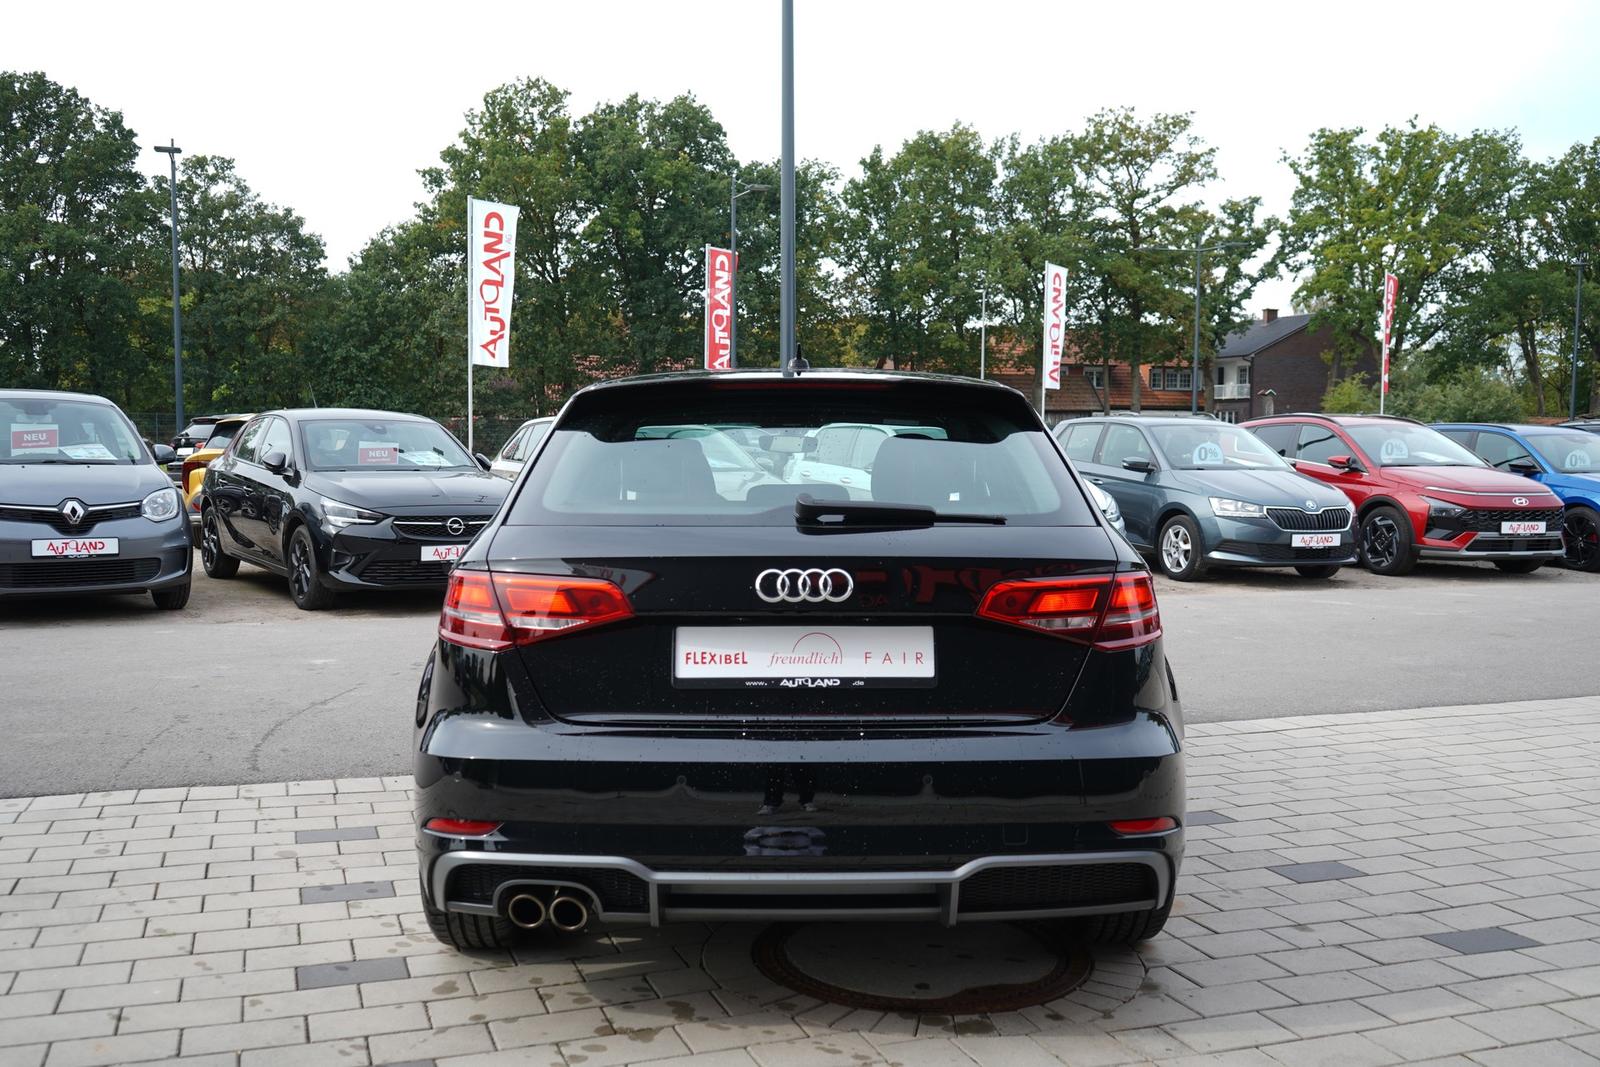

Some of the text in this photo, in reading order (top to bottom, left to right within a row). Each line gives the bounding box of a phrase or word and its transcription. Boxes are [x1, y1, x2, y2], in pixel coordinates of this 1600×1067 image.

[479, 211, 511, 359] AUTOLAND
[712, 255, 731, 369] AUTOLAND
[23, 432, 48, 442] NEU
[368, 450, 389, 458] NEU
[1199, 446, 1218, 461] 0%
[46, 540, 105, 555] AUTOLAND
[684, 650, 924, 668] FLEXIBEL freundlich FAIR
[779, 677, 841, 688] AUTOLAND
